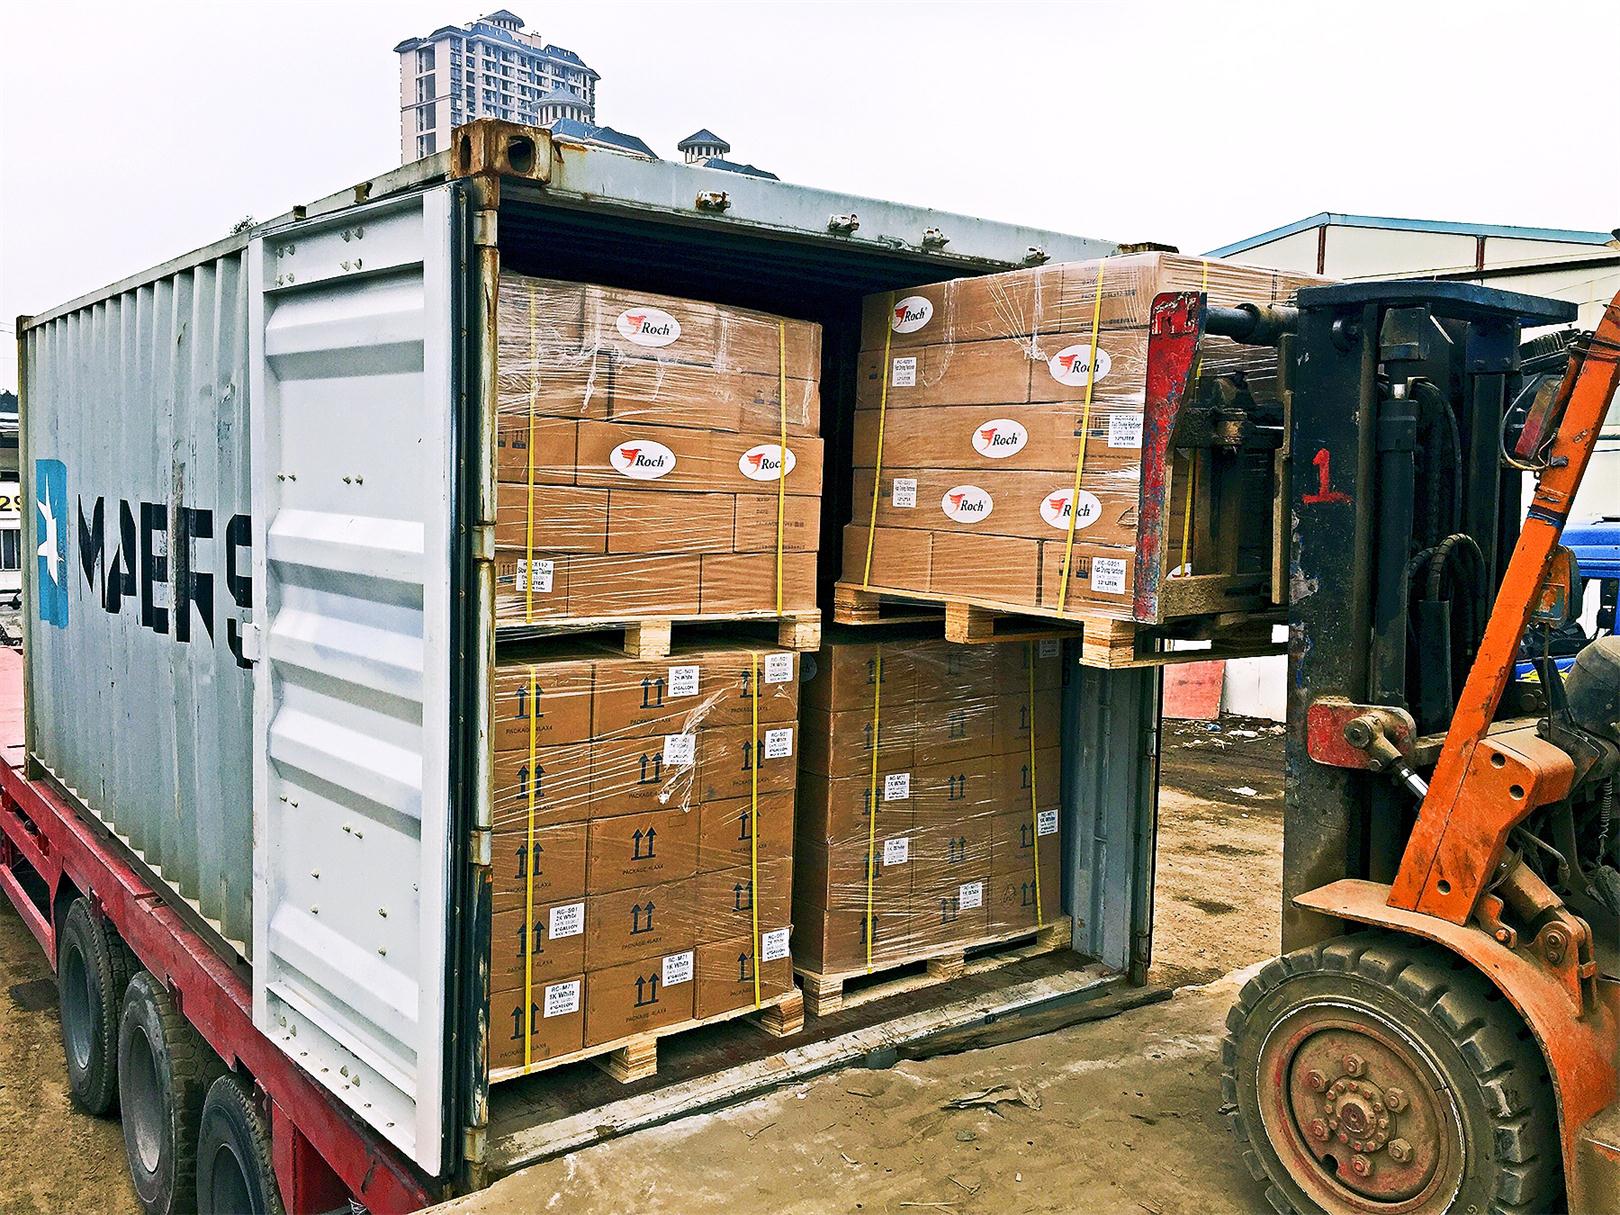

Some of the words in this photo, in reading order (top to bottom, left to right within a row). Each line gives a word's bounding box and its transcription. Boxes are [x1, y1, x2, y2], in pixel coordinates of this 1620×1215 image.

[903, 307, 925, 323] Roch
[641, 321, 671, 336] Roch
[992, 432, 1018, 446] Roch
[635, 454, 664, 468] Roch
[761, 458, 782, 470] Roc
[1302, 448, 1353, 505] 1
[960, 499, 984, 512] Roch
[1062, 503, 1091, 517] Rch
